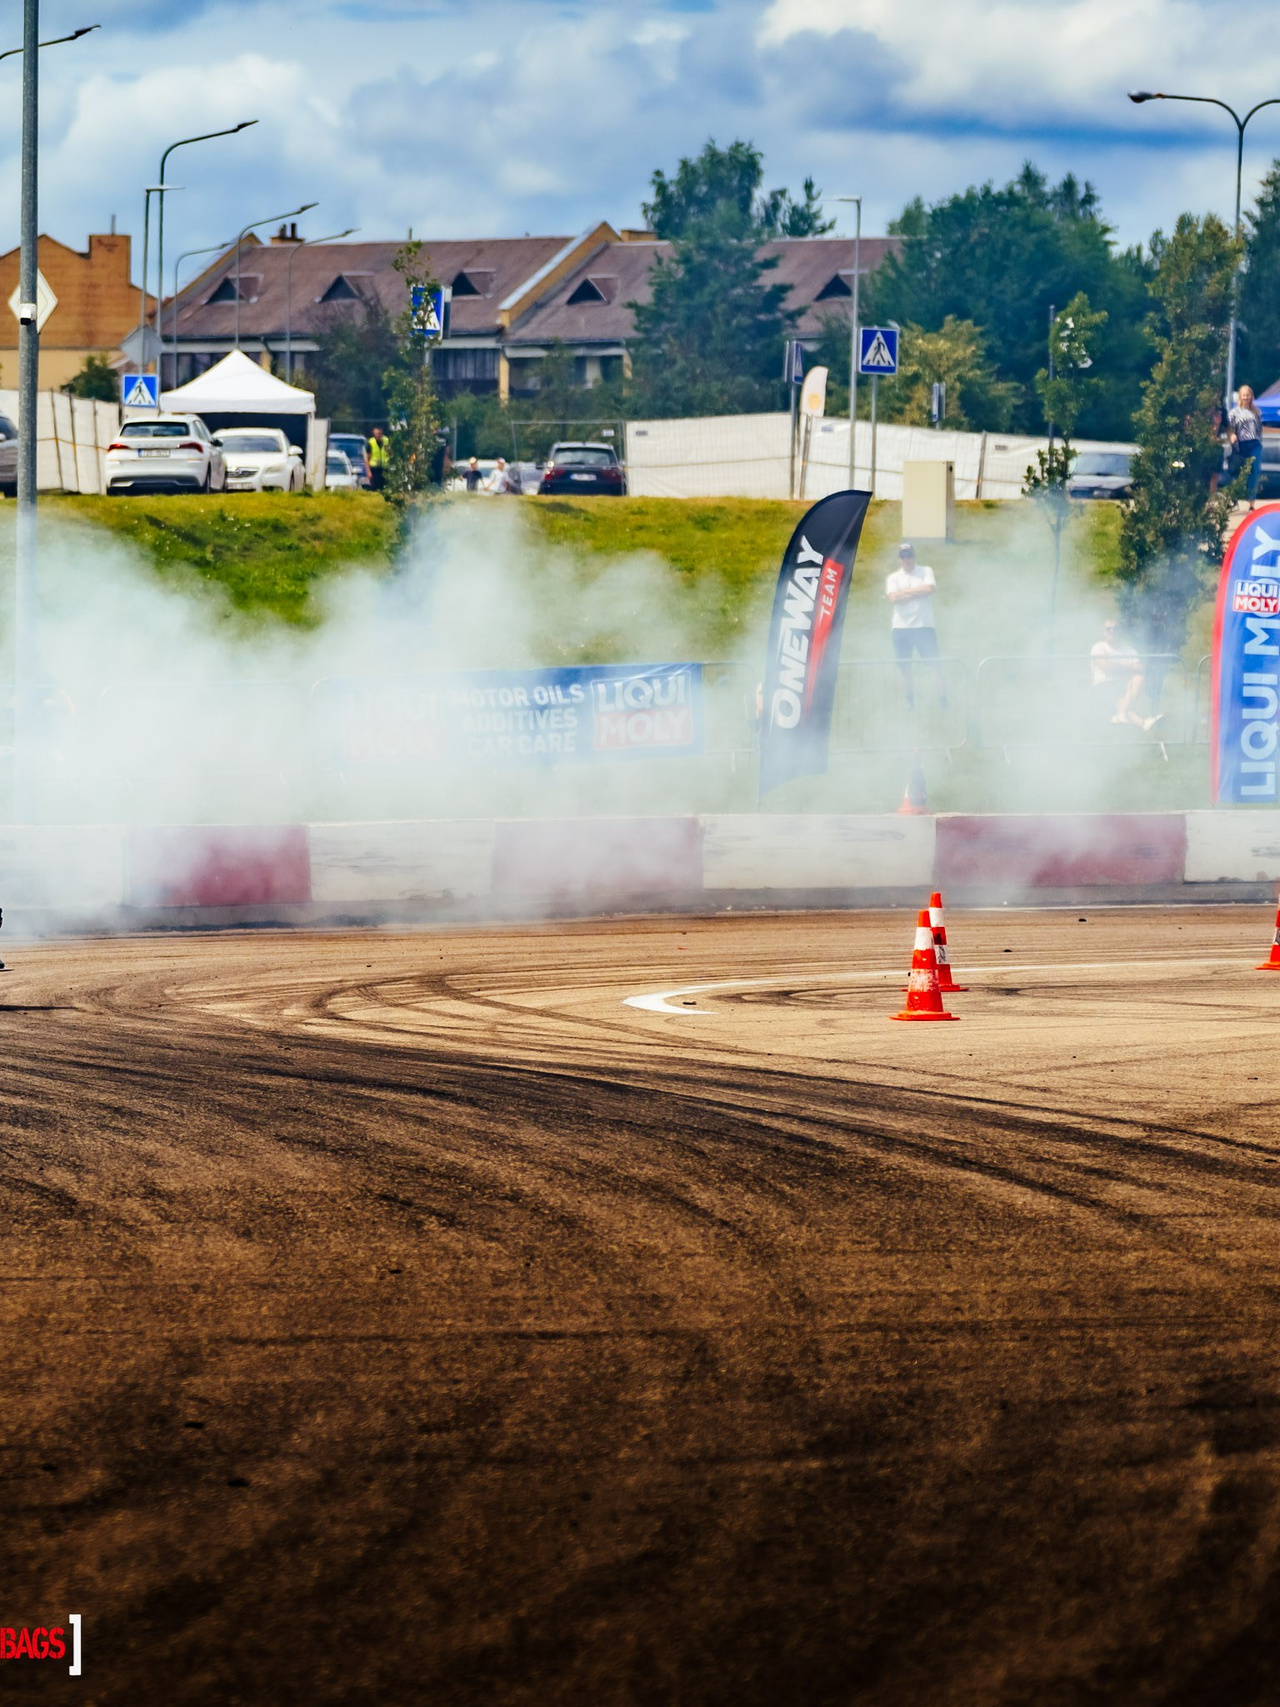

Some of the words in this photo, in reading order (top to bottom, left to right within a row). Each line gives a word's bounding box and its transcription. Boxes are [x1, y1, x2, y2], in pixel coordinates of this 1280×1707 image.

[820, 567, 837, 616] TEAM
[1235, 597, 1278, 612] MOLY
[1237, 582, 1278, 598] LIQUI
[771, 535, 823, 730] ONEWAY
[533, 684, 585, 706] OILS
[597, 675, 686, 711] LIQUI
[464, 708, 579, 733] ADDITIVES
[601, 709, 689, 745] MOLY
[1240, 672, 1280, 796] LIQUI
[519, 732, 577, 754] CARE
